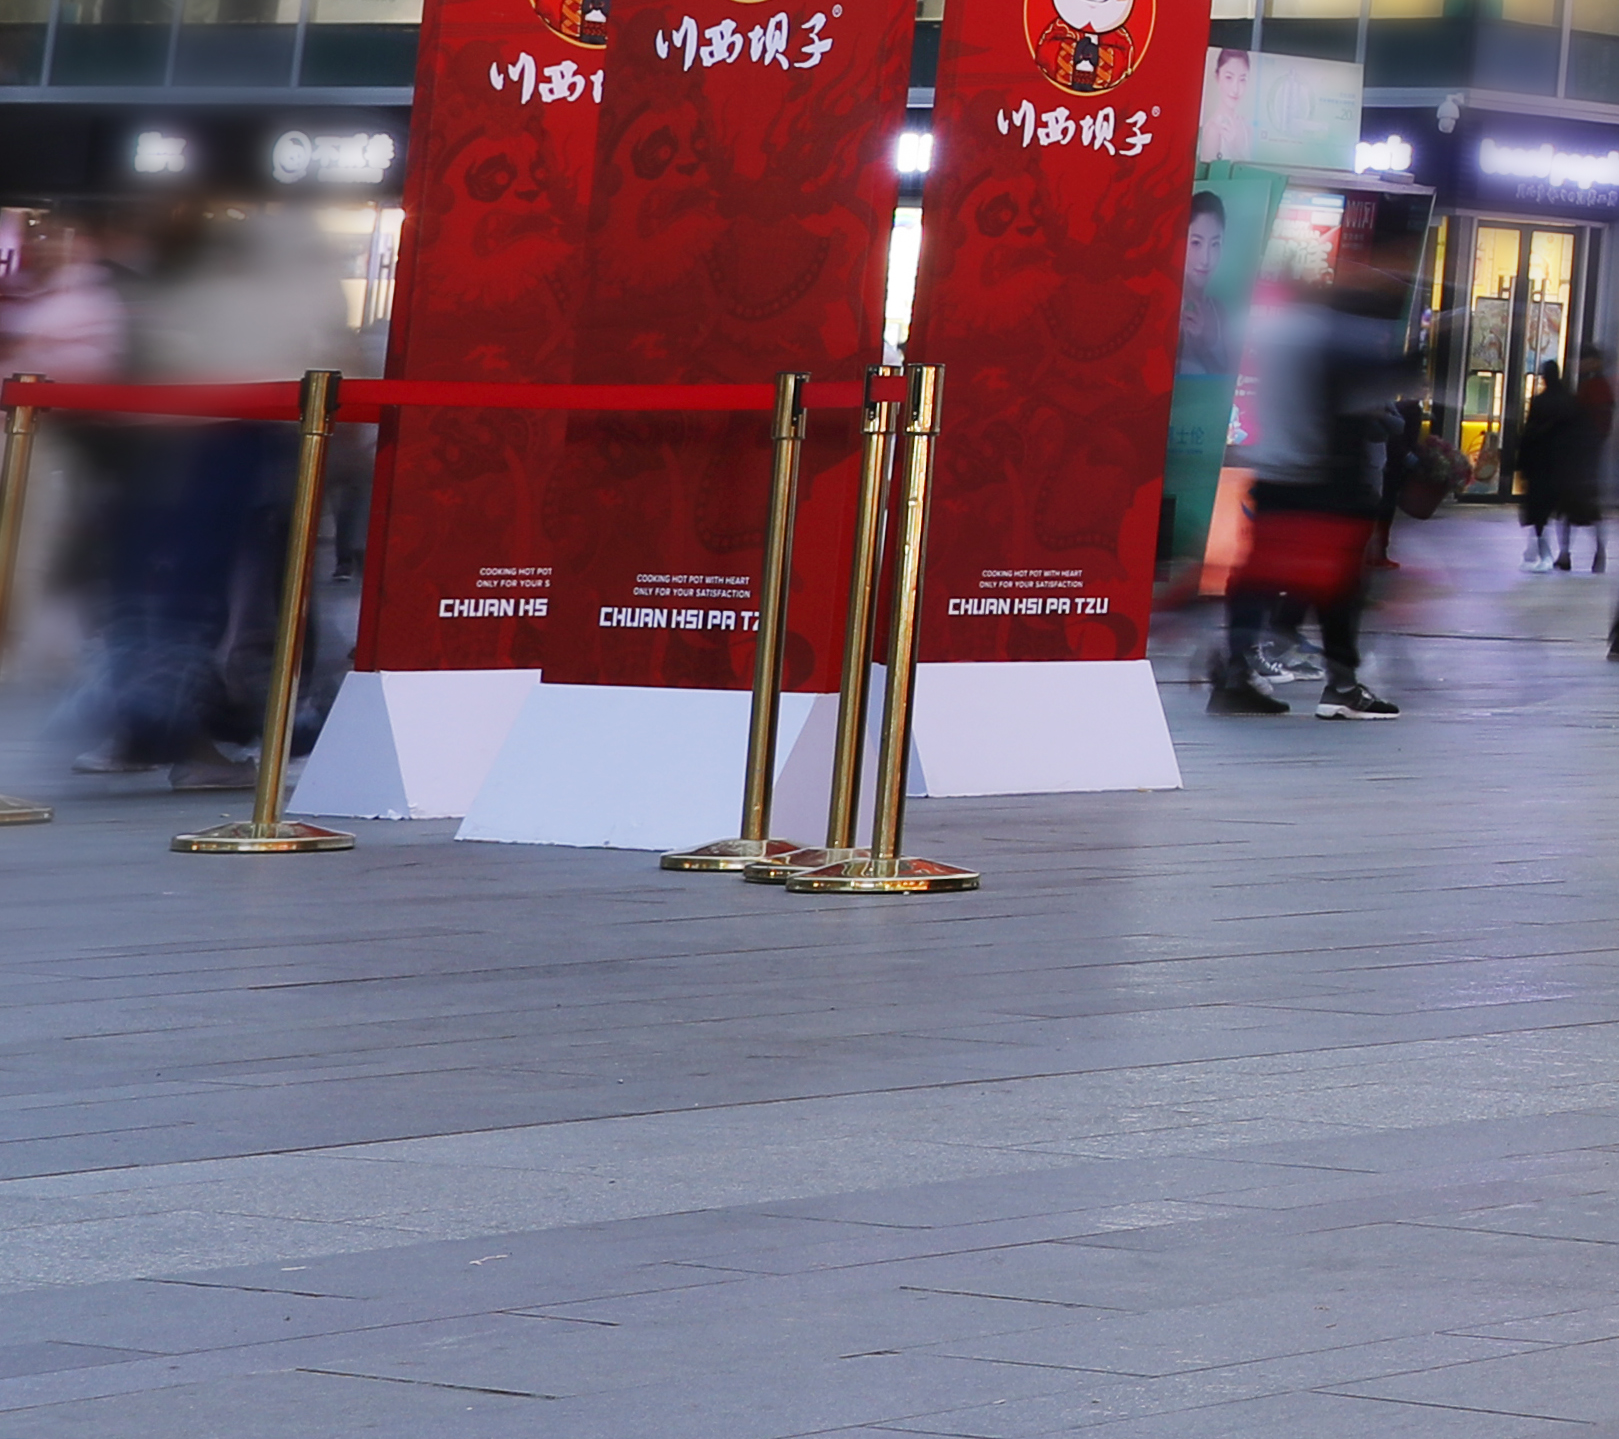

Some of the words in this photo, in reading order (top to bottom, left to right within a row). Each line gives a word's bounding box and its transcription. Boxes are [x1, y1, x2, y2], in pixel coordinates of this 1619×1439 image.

[655, 11, 834, 72] 川西坝子
[996, 98, 1153, 158] 川西坝子
[671, 574, 686, 584] HOT
[688, 575, 704, 585] POT
[725, 576, 750, 586] HEART
[633, 586, 653, 596] ONLY
[655, 587, 670, 597] FOR
[672, 587, 694, 598] YOUR
[438, 598, 515, 618] CHUAN
[518, 598, 549, 617] HS
[948, 598, 1011, 615] CHUAN
[1013, 598, 1043, 615] HSI
[1045, 598, 1071, 614] PA
[1074, 597, 1109, 614] TZU
[599, 606, 668, 629] CHUAN
[671, 608, 703, 630] HSI
[707, 610, 735, 631] PA
[740, 611, 761, 632] TZ
